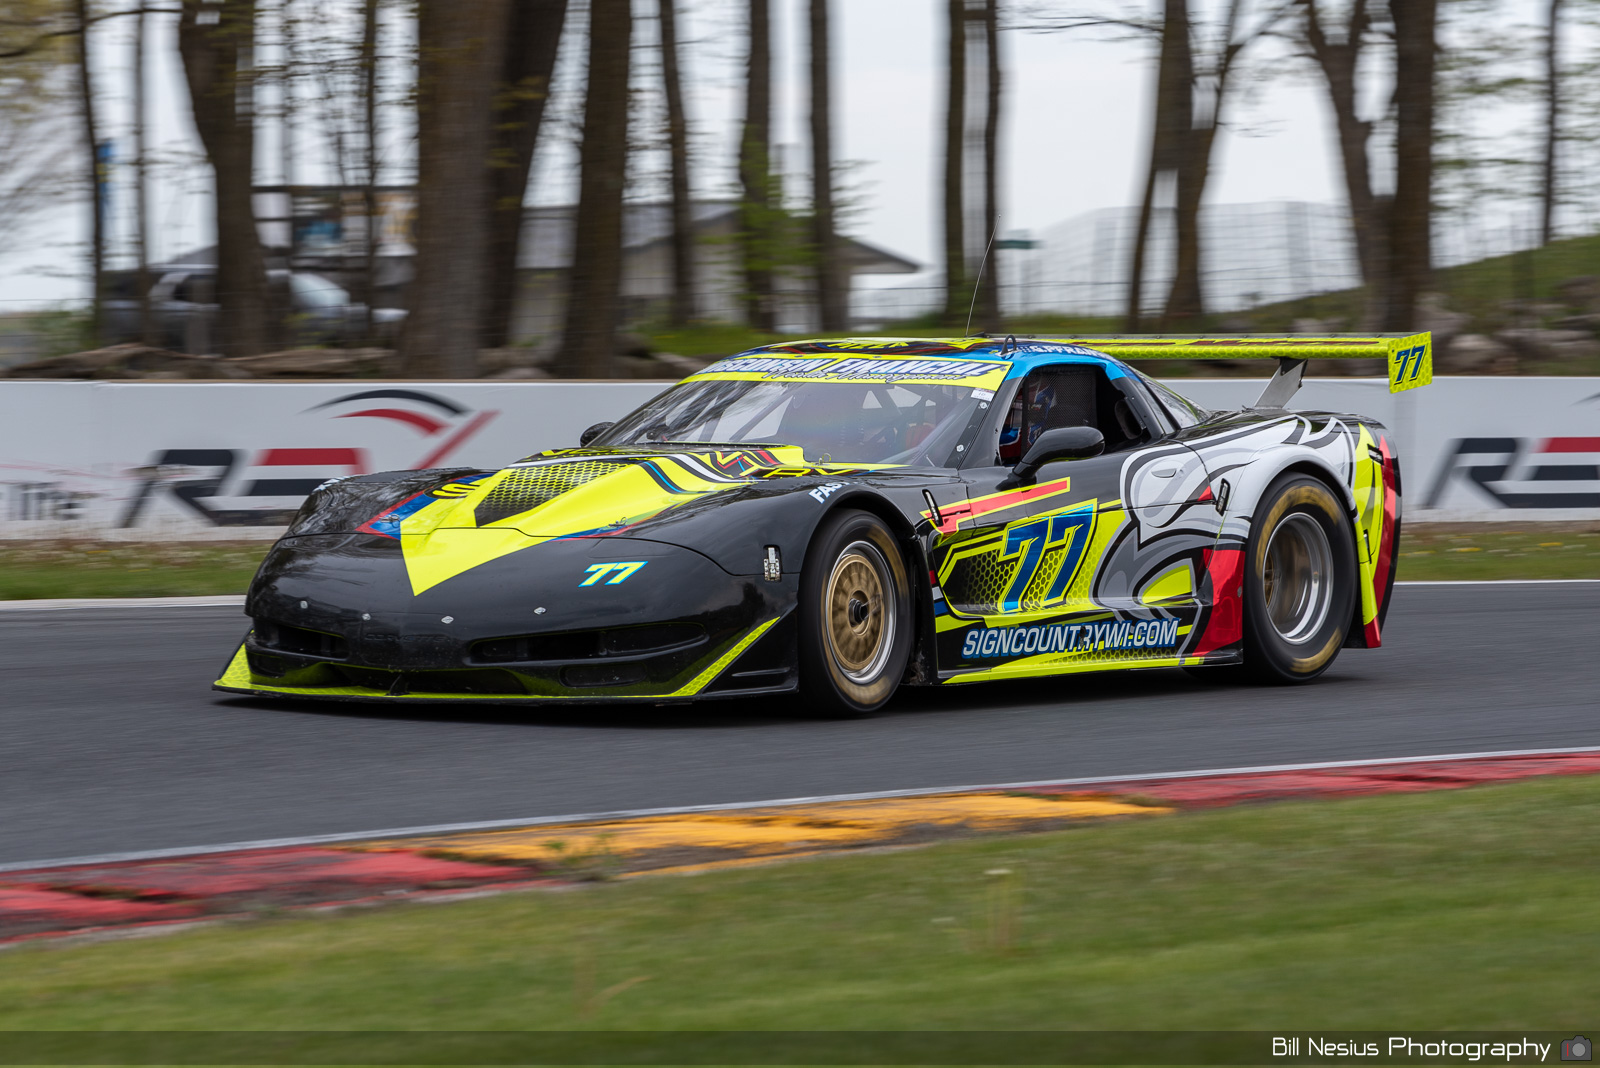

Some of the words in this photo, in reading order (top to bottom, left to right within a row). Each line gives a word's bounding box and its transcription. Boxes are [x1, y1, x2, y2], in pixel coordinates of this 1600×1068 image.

[821, 357, 1007, 377] FINANCIAL
[1394, 344, 1427, 386] 77
[578, 560, 649, 588] 77
[1000, 502, 1095, 612] 77
[963, 617, 1181, 660] SIGNCOUNTRYWI.COM
